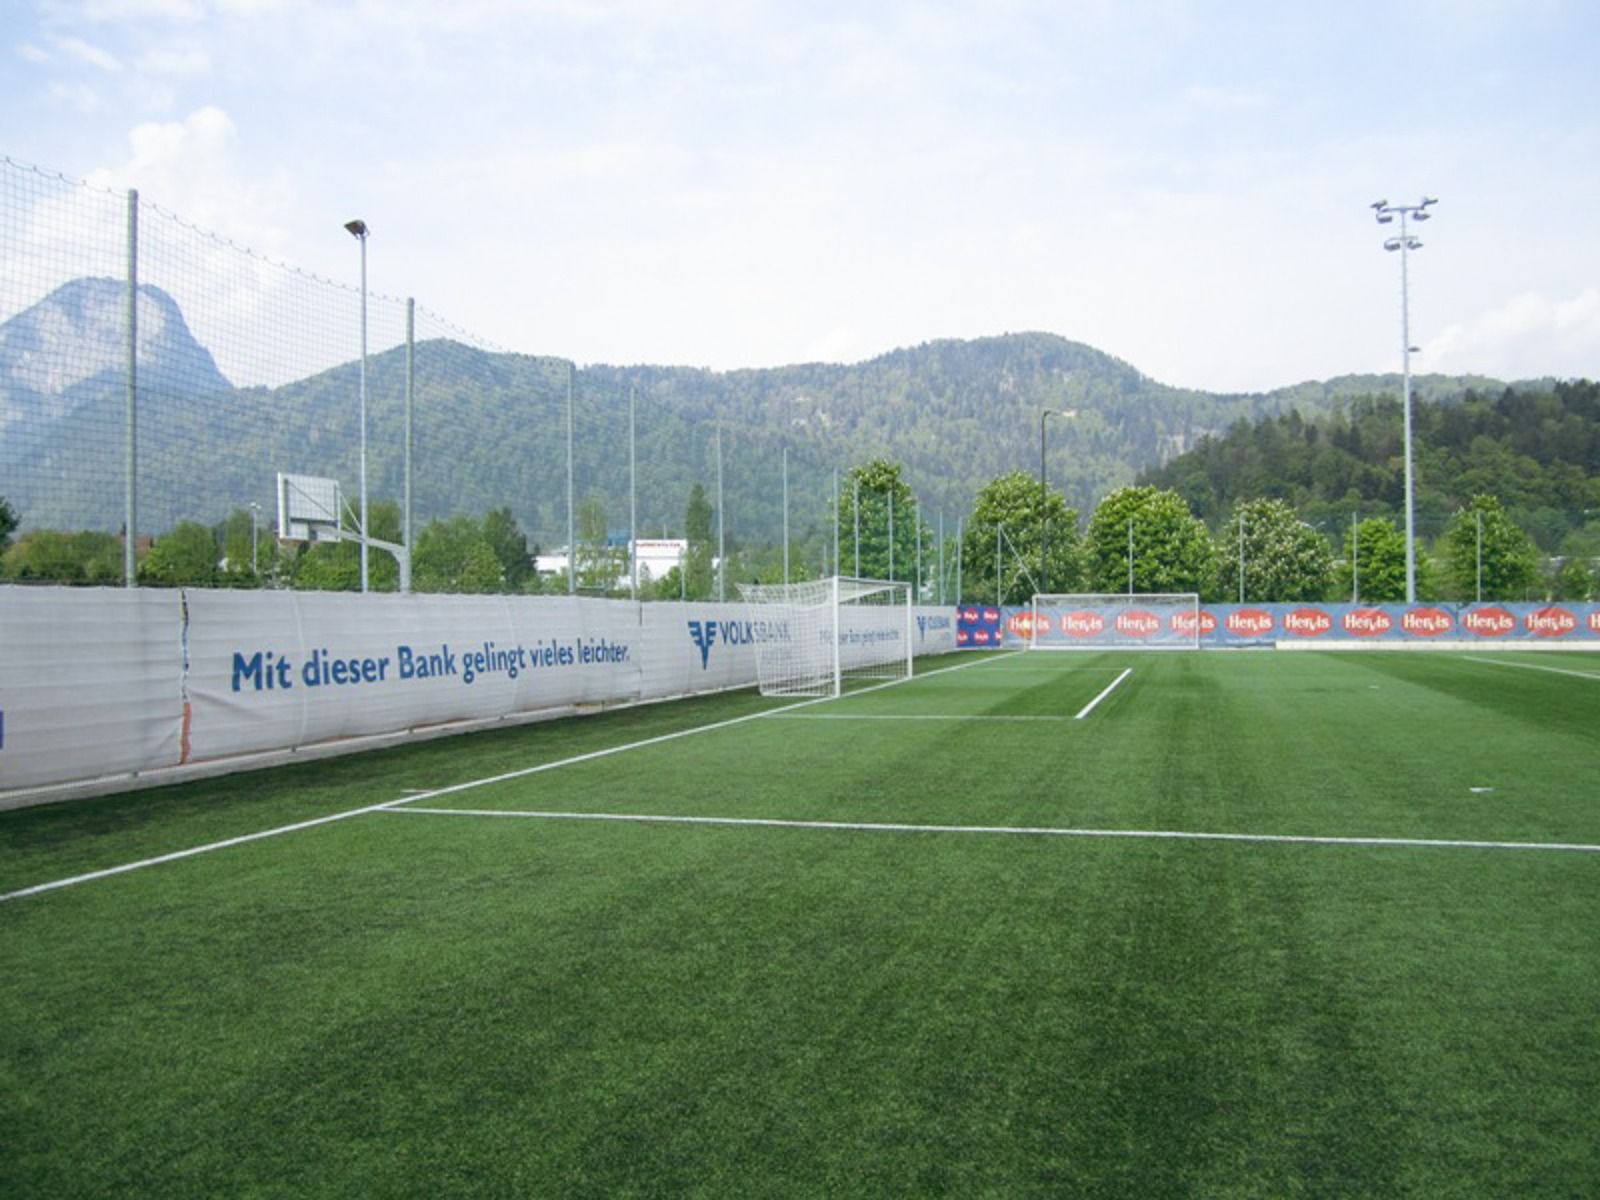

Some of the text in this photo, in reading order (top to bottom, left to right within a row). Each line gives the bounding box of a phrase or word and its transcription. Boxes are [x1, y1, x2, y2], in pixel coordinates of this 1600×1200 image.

[1010, 616, 1050, 631] Heris
[1062, 615, 1103, 632] Hervis
[1117, 615, 1159, 632] Hervis
[1229, 614, 1273, 631] Hervis
[1285, 614, 1330, 630] Hervis
[1345, 614, 1390, 630] Hervis
[1404, 614, 1450, 630] Hervis
[1466, 614, 1513, 630] Hervis
[1527, 613, 1574, 630] Hervis
[720, 620, 791, 646] VOLKSBANK
[231, 637, 629, 693] Mit dieser Bank gelingt vieles leichter.
